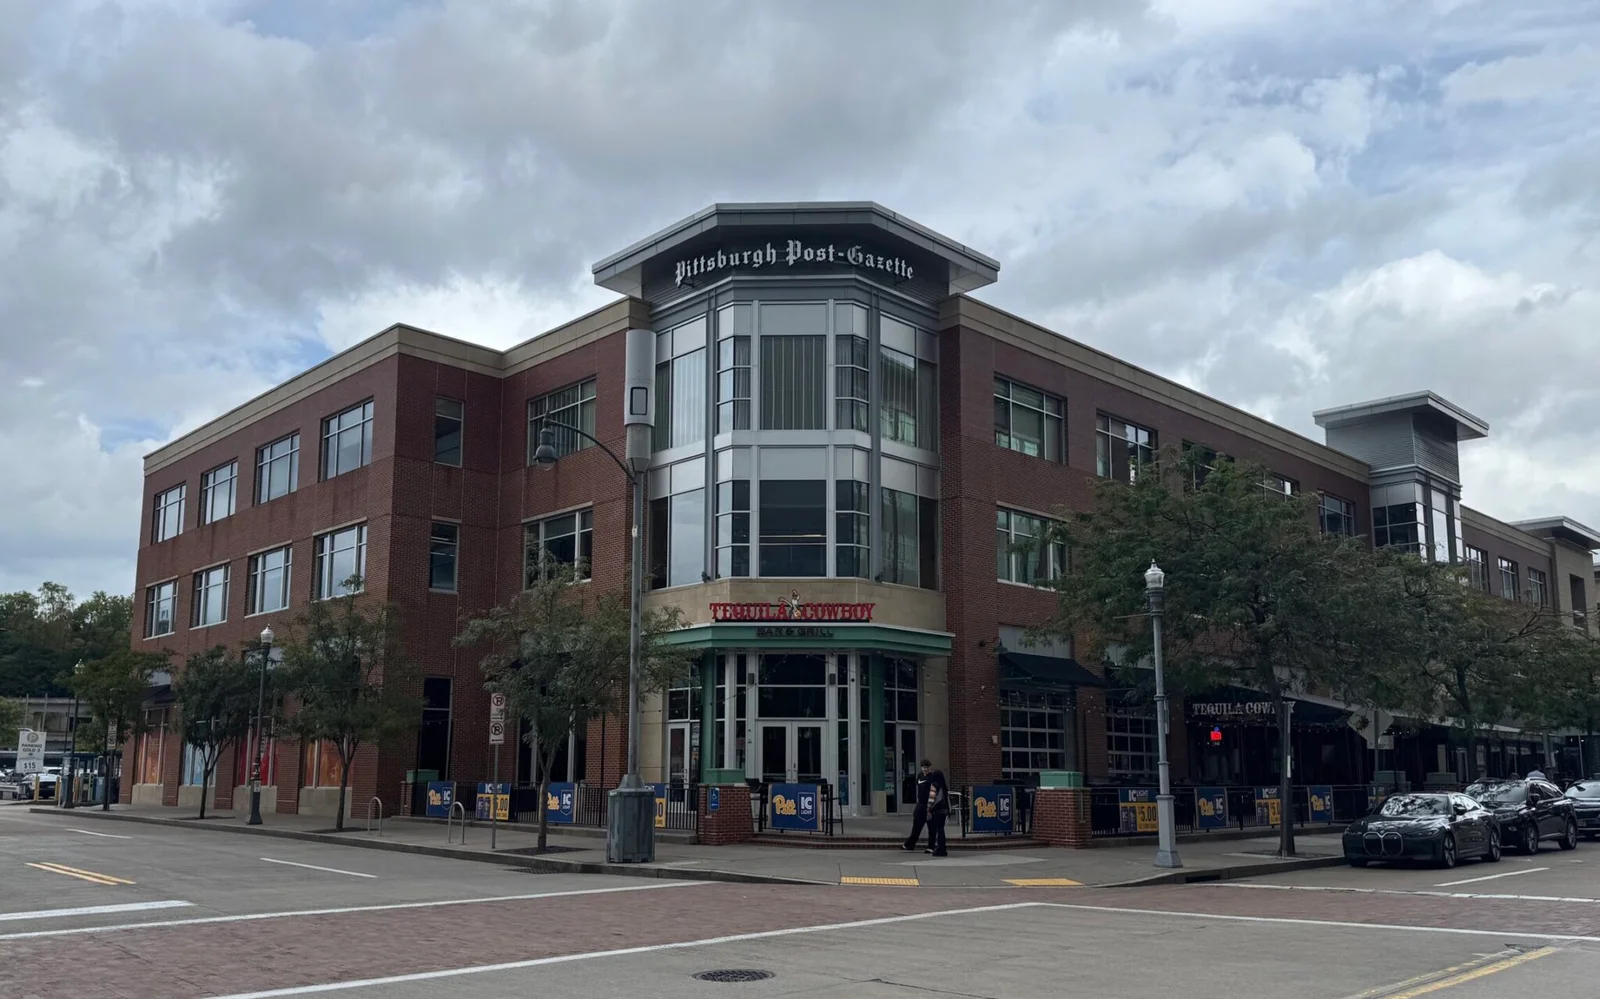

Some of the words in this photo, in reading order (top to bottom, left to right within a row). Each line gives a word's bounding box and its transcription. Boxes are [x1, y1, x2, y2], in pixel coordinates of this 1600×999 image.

[675, 242, 777, 287] Pittsburgh
[786, 240, 914, 279] Post-Gazette
[710, 603, 789, 620] TEQUILA
[801, 603, 876, 620] COWBOY
[757, 627, 783, 637] BAR
[797, 627, 834, 637] GRILL
[1192, 702, 1244, 715] TEQUILA
[443, 790, 451, 801] IC
[563, 793, 572, 805] IC
[1128, 790, 1137, 802] IC
[772, 794, 797, 815] Pitt
[800, 796, 812, 810] IC
[974, 796, 997, 818] Pitt
[1000, 798, 1010, 811] IC
[1216, 798, 1224, 810] IC
